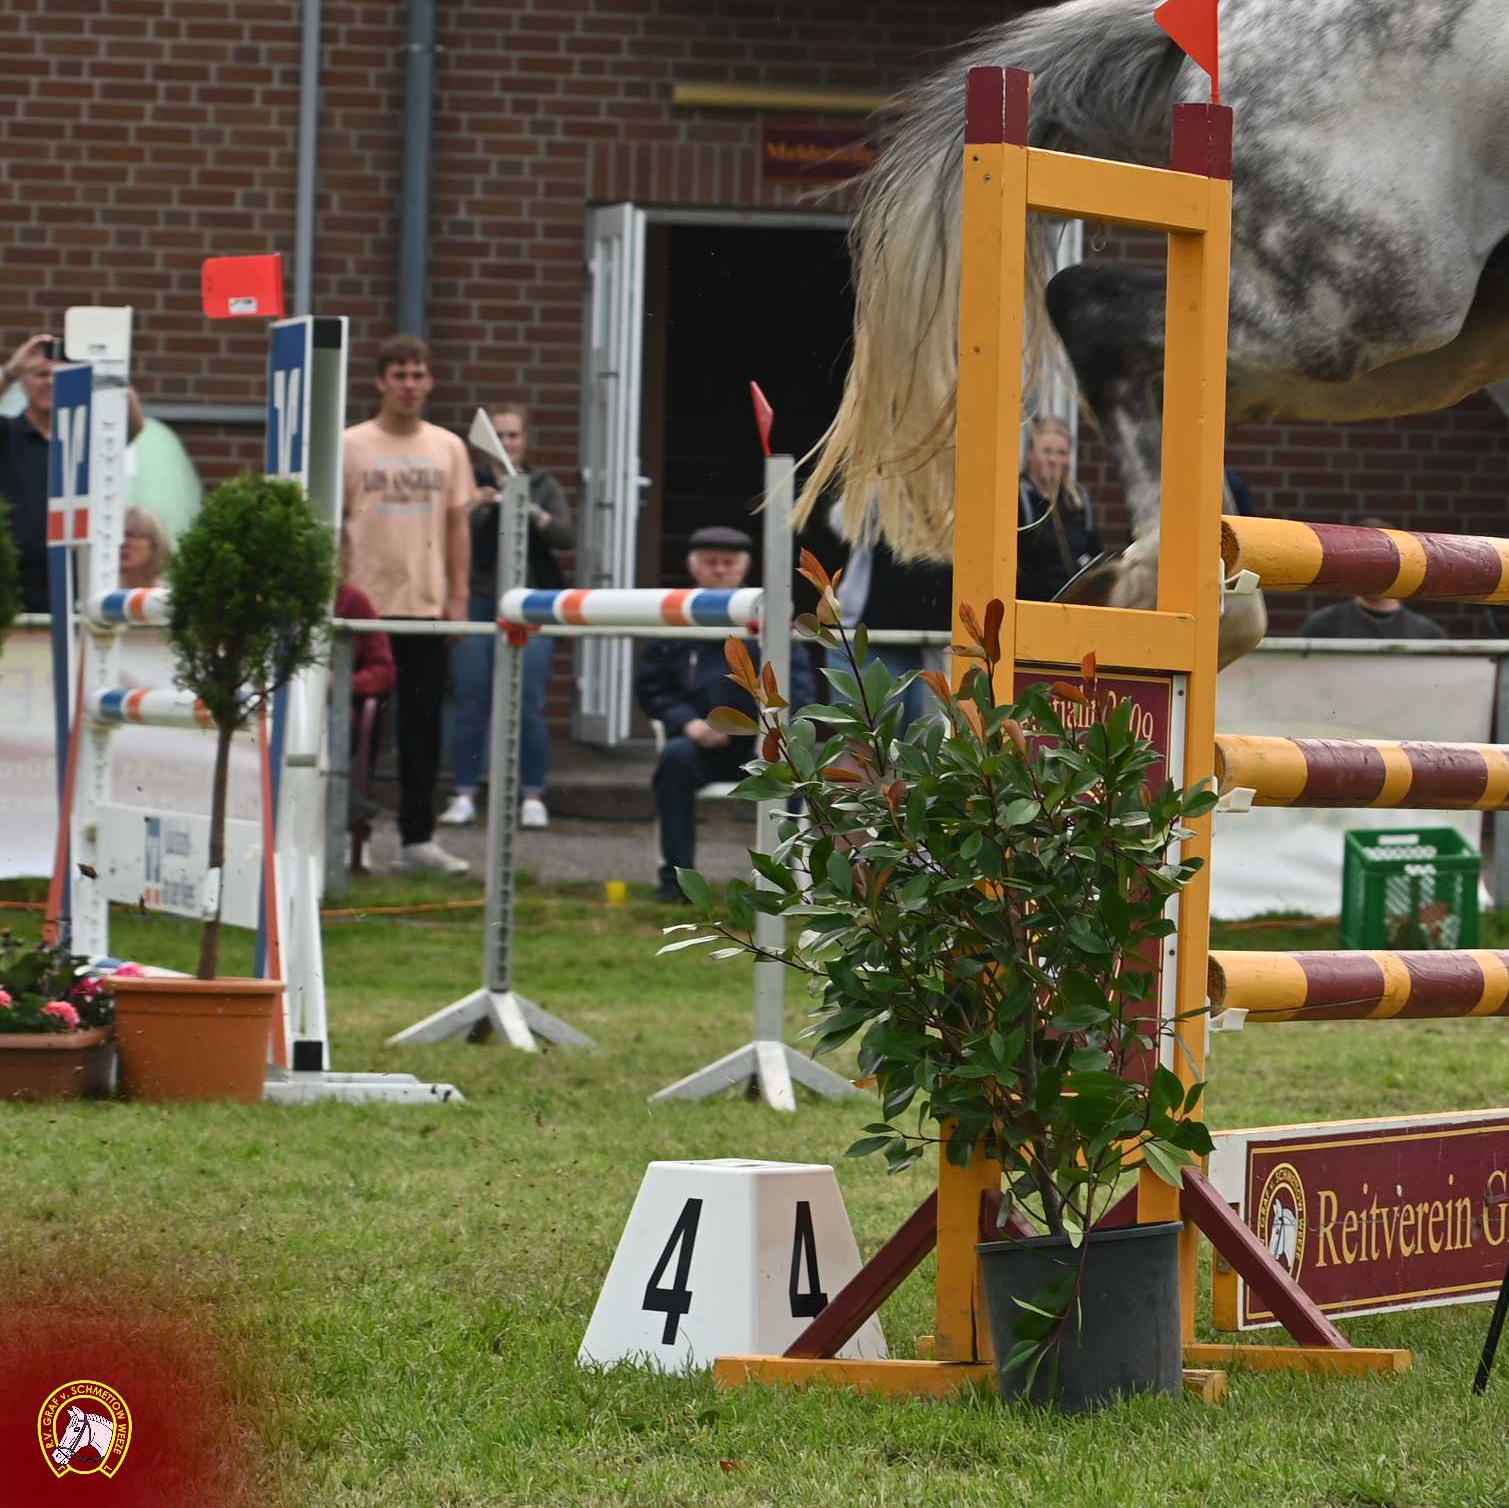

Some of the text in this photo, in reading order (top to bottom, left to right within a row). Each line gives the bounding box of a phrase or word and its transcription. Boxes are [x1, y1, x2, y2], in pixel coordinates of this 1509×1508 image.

[642, 1198, 703, 1346] 4
[789, 1201, 829, 1319] 4
[1315, 1174, 1473, 1268] Reitverein
